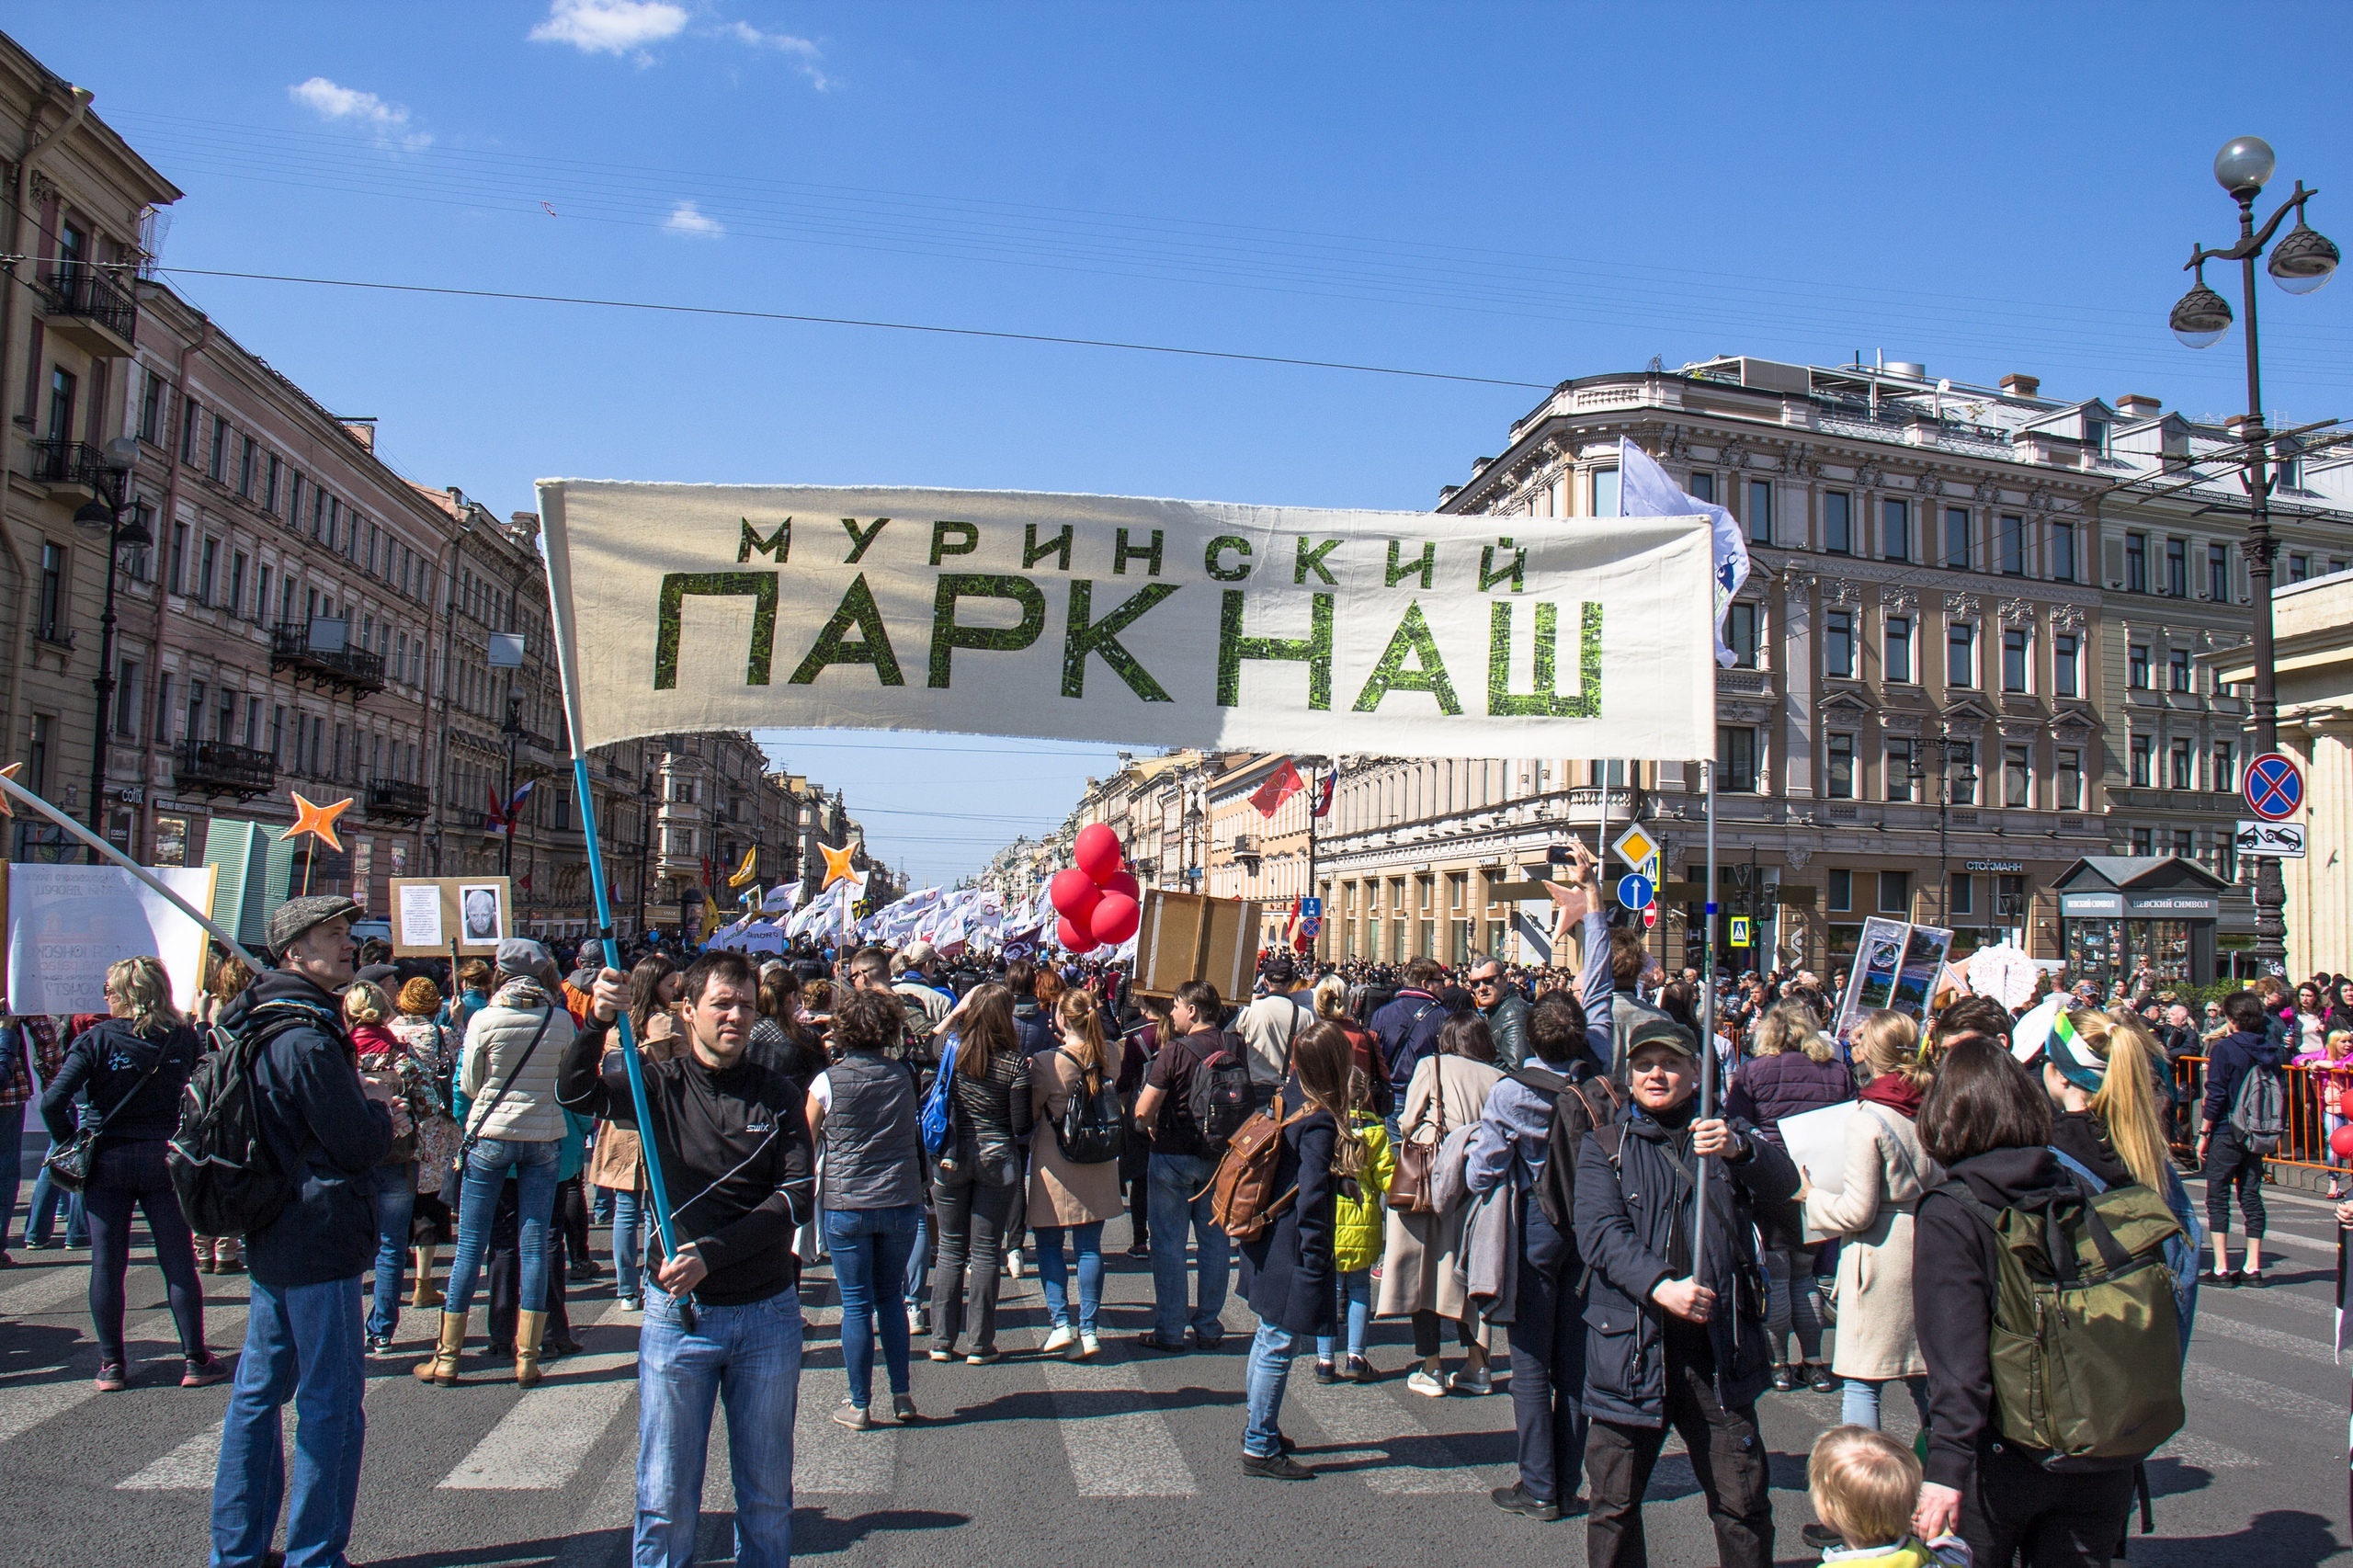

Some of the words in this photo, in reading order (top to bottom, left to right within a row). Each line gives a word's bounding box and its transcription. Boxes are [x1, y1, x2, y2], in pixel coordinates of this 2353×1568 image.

[736, 515, 1528, 593] МУРИНСКИЙ
[1965, 860, 2023, 872] СТОКМАНН
[2132, 898, 2173, 909] НЕВСКИЙ
[2173, 899, 2210, 909] СИМВОЛ
